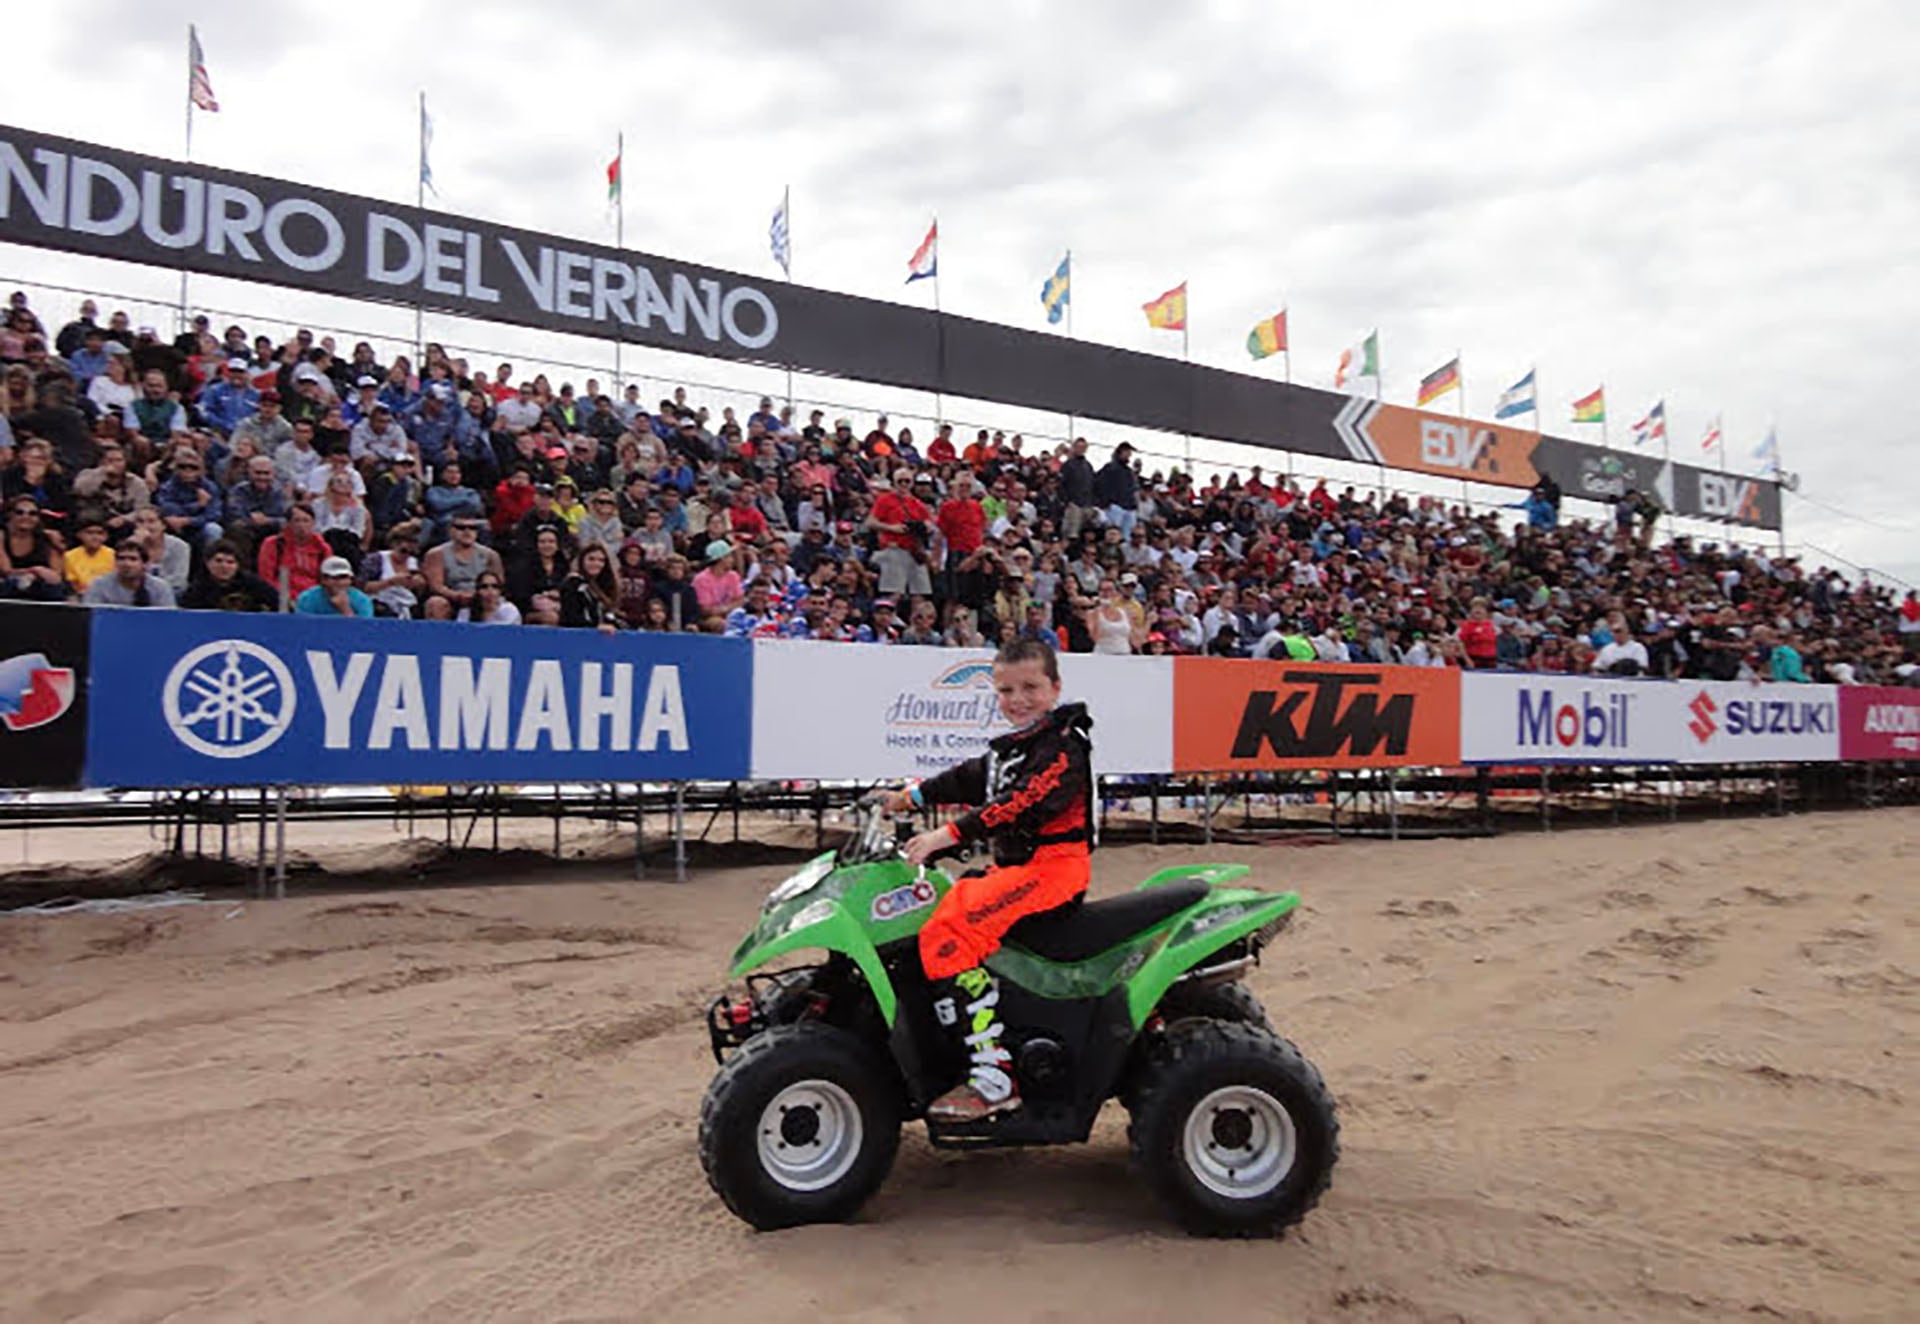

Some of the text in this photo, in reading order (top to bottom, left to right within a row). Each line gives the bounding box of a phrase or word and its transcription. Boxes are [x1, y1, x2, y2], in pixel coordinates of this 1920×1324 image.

[367, 212, 500, 302] DEL
[500, 239, 779, 349] VERANO
[306, 650, 690, 752] YAMAHA
[885, 693, 979, 725] Howard
[1230, 671, 1415, 758] KTM
[1518, 689, 1628, 748] Mobil
[1726, 701, 1834, 734] SUZUKI
[886, 734, 926, 748] Hotel
[930, 735, 941, 748] &
